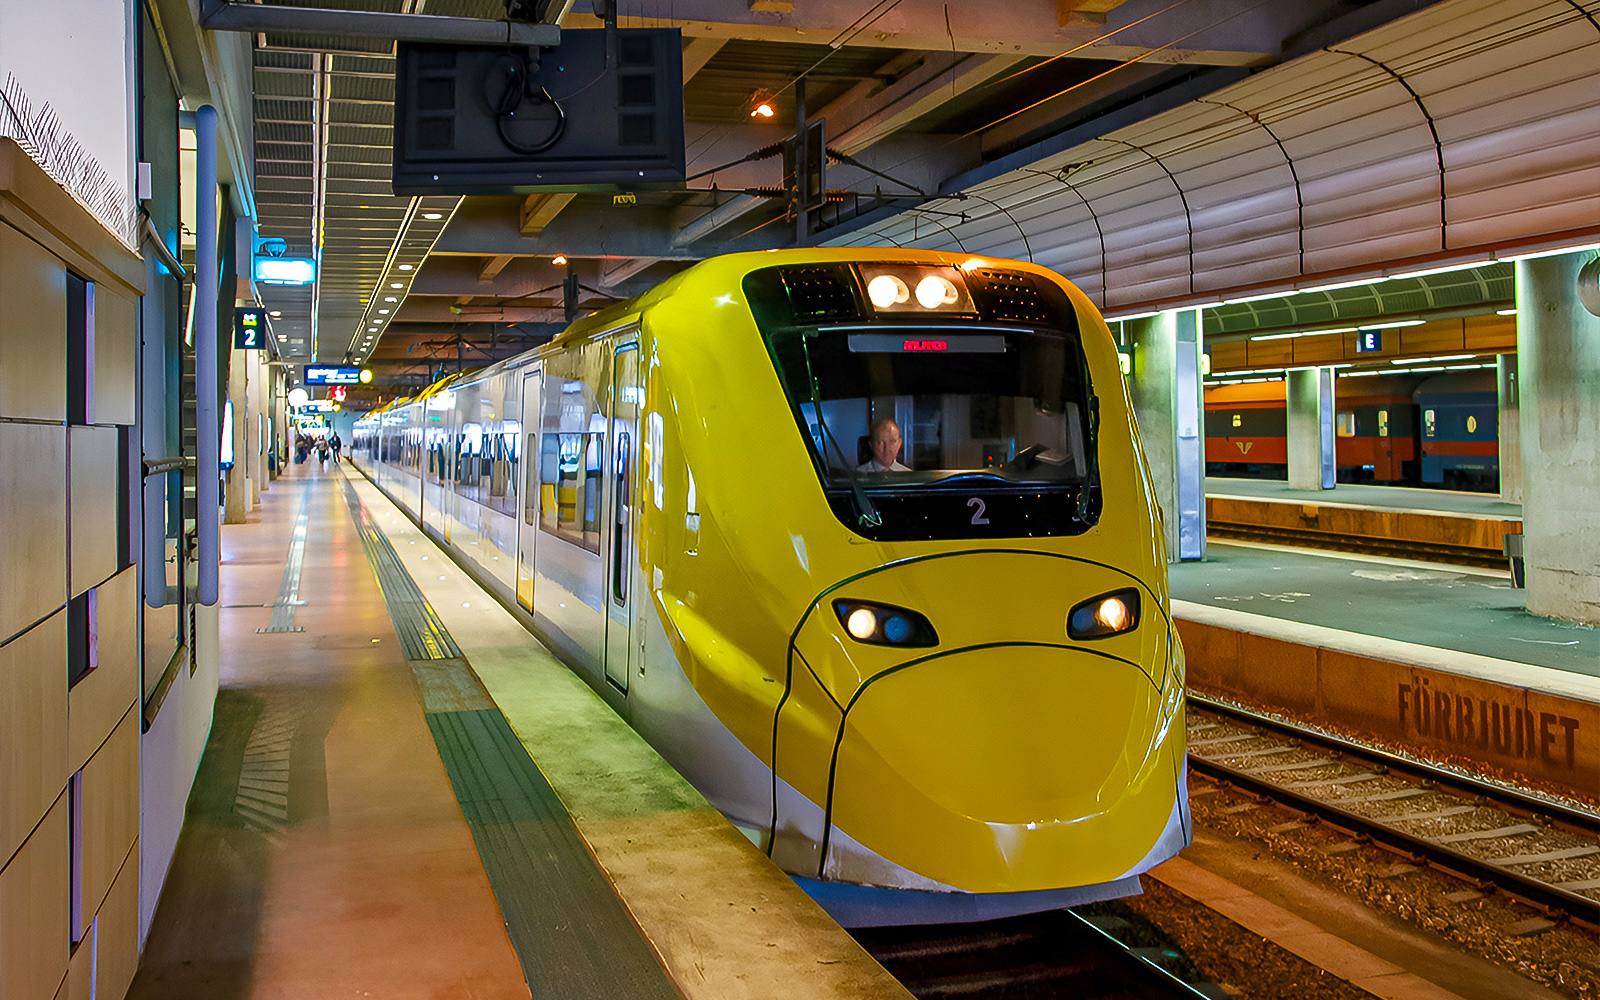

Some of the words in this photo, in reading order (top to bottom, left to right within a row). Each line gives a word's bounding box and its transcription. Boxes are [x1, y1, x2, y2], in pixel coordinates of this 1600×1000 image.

[244, 329, 256, 346] 2
[1365, 333, 1375, 349] E
[966, 497, 990, 525] 2
[1398, 676, 1579, 770] FÖRBJUDET
